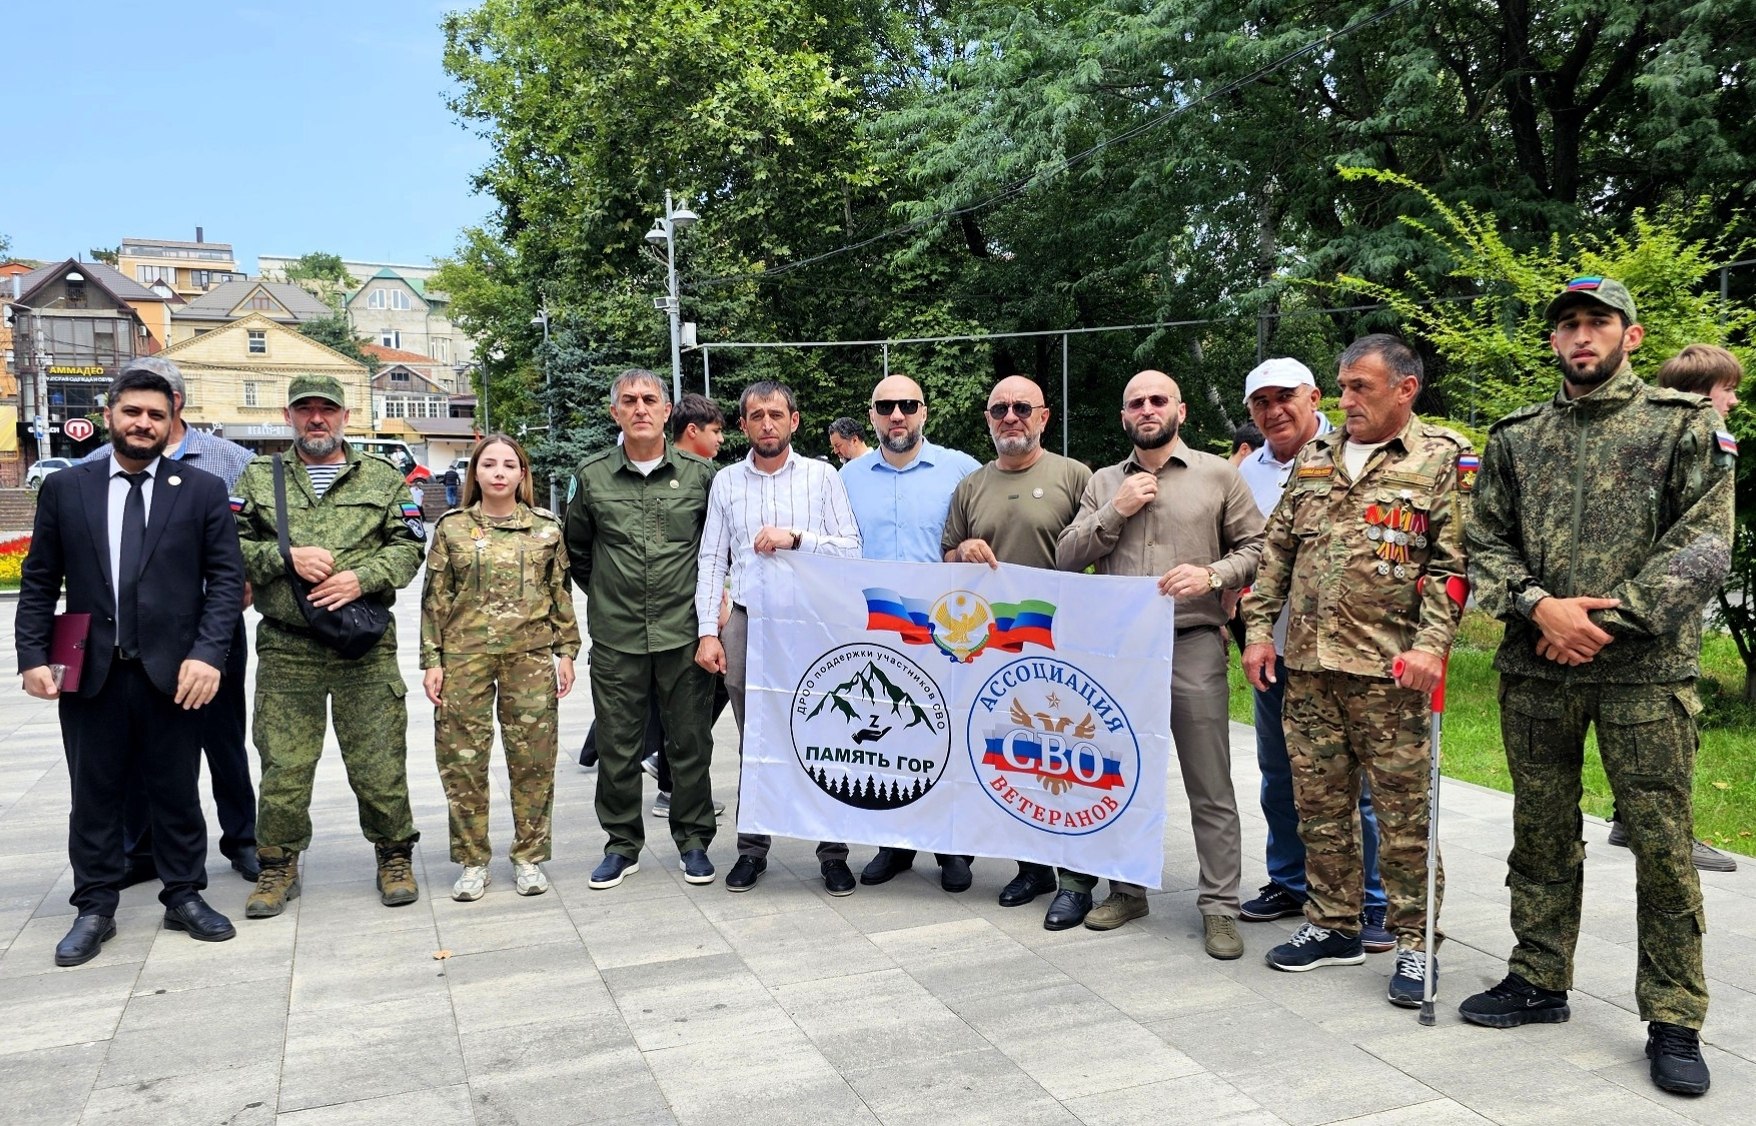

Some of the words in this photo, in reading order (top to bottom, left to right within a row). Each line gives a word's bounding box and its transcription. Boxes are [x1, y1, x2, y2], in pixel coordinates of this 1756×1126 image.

[49, 366, 104, 376] АММАДЕО
[797, 679, 815, 715] ДРОО
[814, 650, 873, 680] поддержки
[876, 651, 935, 700] участников
[932, 703, 945, 730] СВО
[979, 662, 1124, 733] АССОЦИАЦИЯ
[869, 714, 880, 728] Z
[805, 746, 890, 768] ПАМЯТЬ
[896, 755, 935, 774] ГОР
[1002, 728, 1104, 783] СВО
[989, 775, 1119, 828] ВЕТЕРАНОВ
